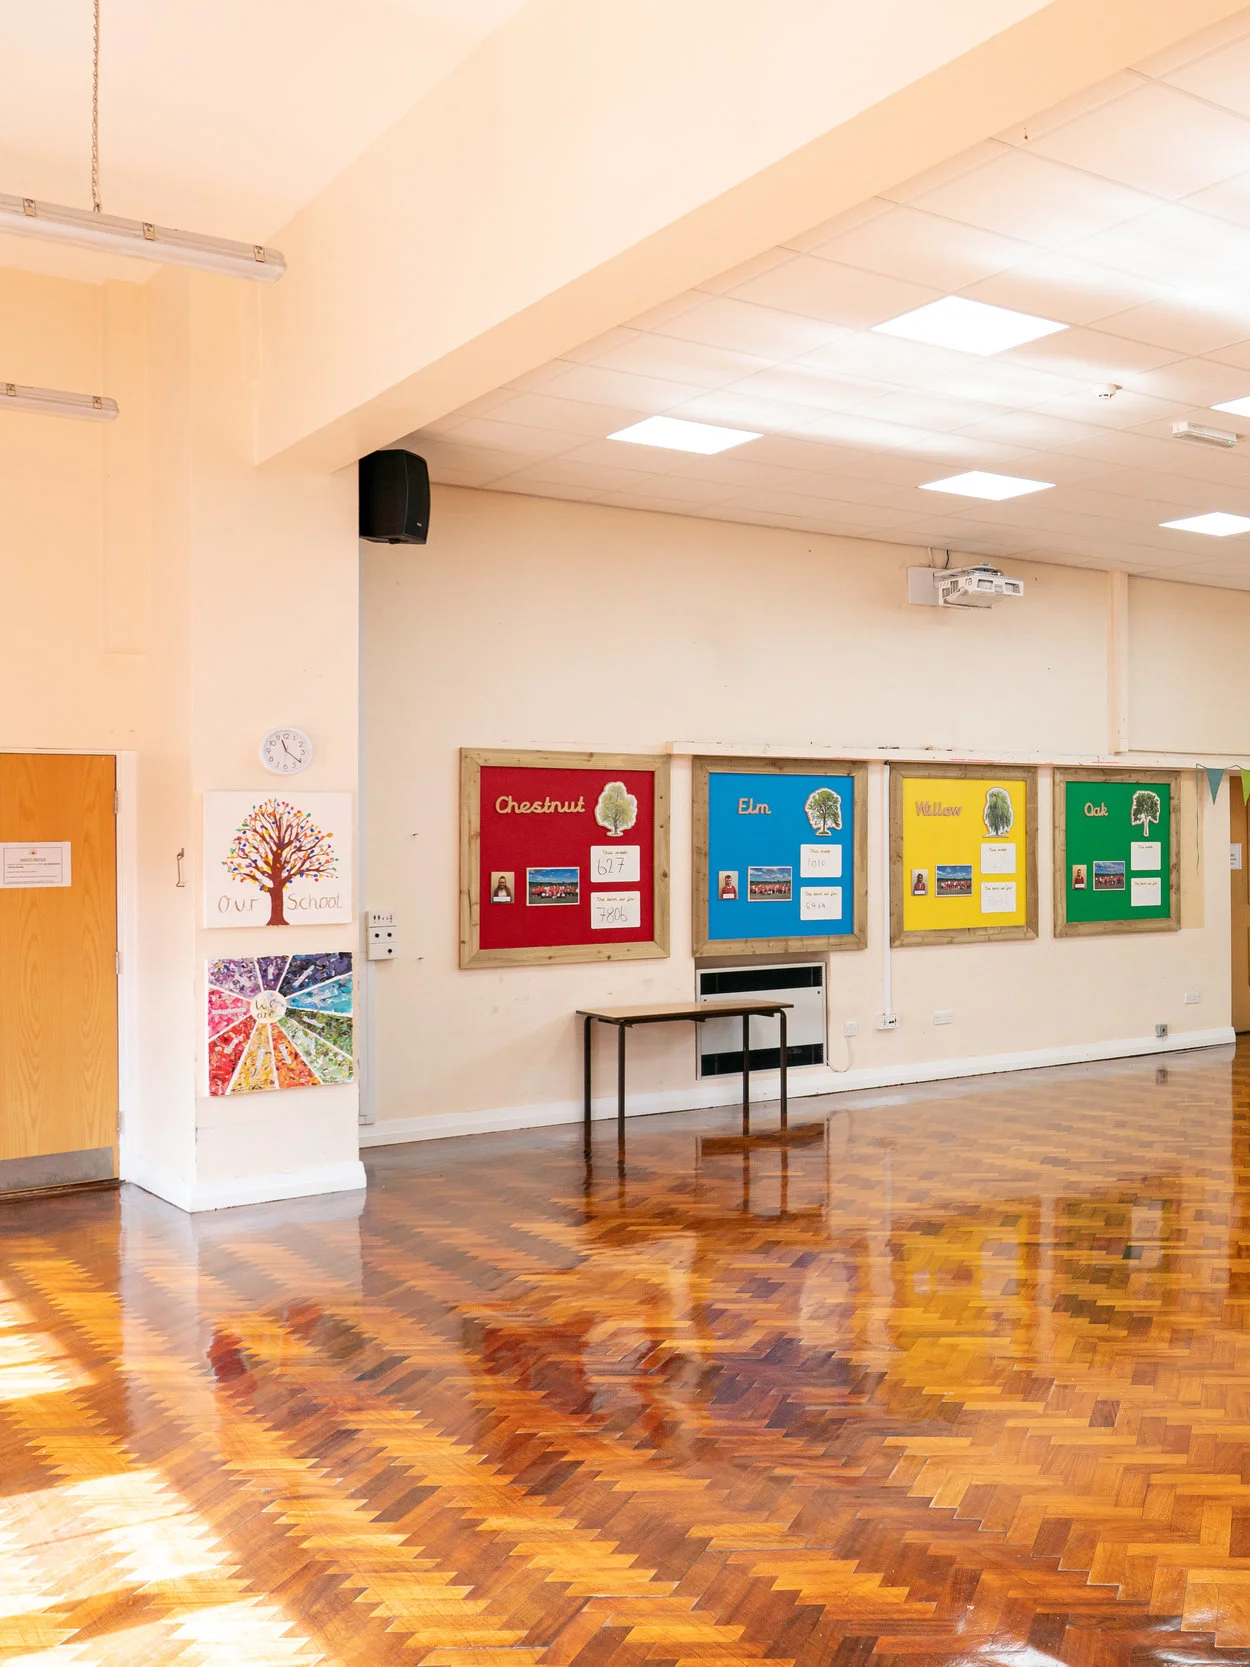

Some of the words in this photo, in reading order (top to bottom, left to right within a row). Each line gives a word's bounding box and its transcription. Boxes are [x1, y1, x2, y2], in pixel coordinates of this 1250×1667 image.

[495, 795, 586, 814] Chestnut
[738, 797, 772, 815] Elm
[915, 800, 963, 817] Willow
[1084, 802, 1109, 817] Oak
[597, 857, 625, 876] 627
[218, 895, 260, 913] Our
[287, 892, 344, 911] School
